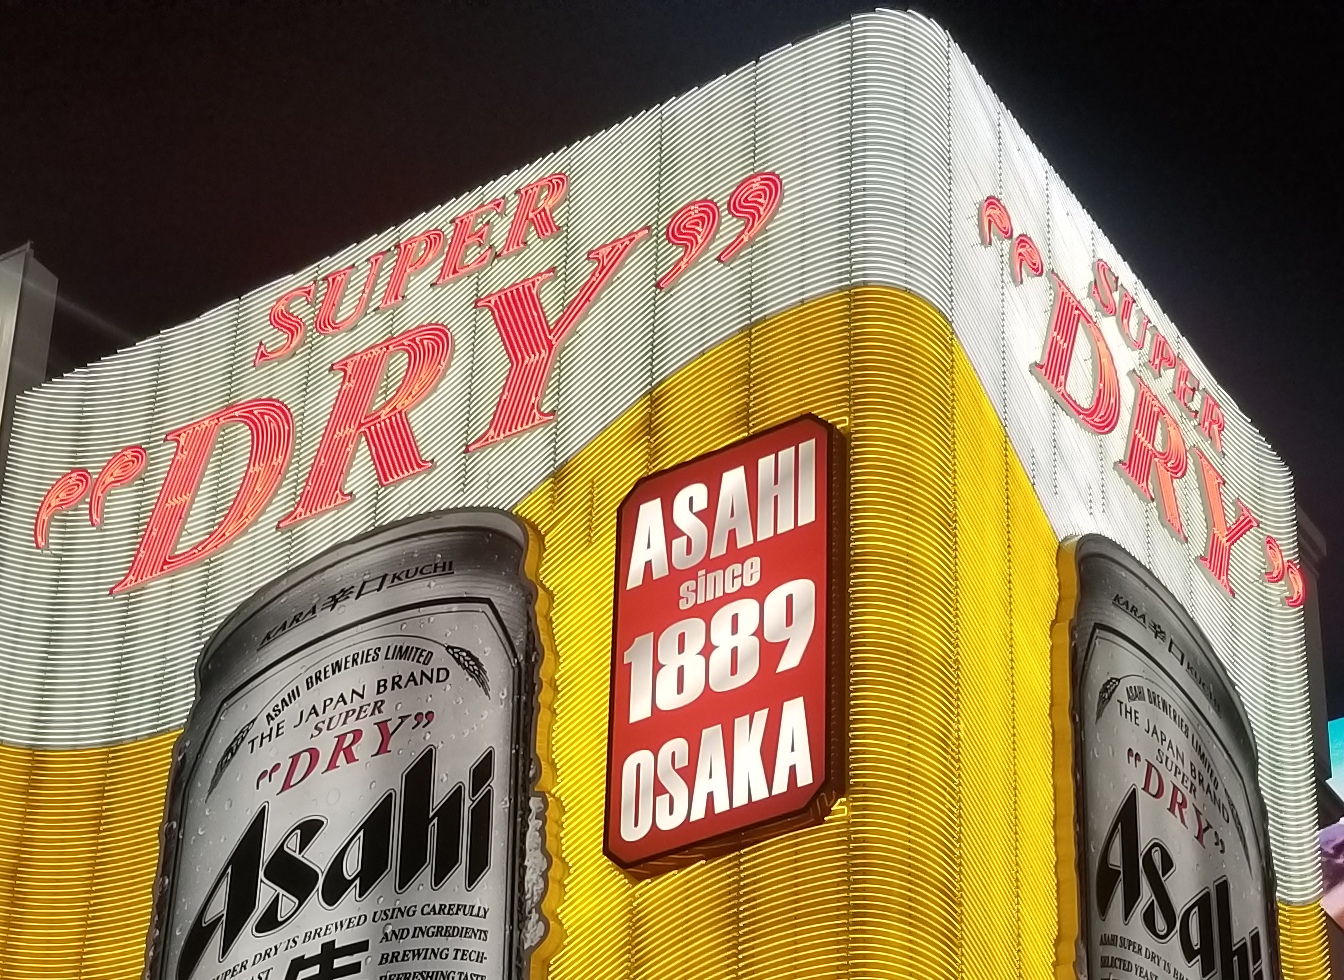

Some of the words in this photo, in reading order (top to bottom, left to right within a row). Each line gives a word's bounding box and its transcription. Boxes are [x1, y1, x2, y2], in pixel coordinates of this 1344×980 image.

[255, 171, 570, 367] SUPER
[1089, 260, 1225, 455] SUPER
[626, 438, 816, 590] ASAHI
[679, 556, 761, 610] since
[265, 685, 301, 726] ASAHI
[306, 646, 381, 691] BREWERIES
[384, 644, 434, 666] LIMITED
[623, 579, 816, 724] 1889
[248, 720, 286, 754] THE
[294, 684, 366, 729] JAPAN
[377, 667, 451, 695] BRAND
[310, 699, 385, 739] SUPER
[620, 696, 814, 842] OSAKA
[1117, 699, 1140, 727] THE
[1144, 718, 1185, 767] JAPAN
[1190, 761, 1230, 823] BRAND
[1156, 748, 1197, 799] SUPER
[251, 942, 281, 971] DRY
[301, 914, 368, 944] BREWED
[372, 904, 417, 924] USING
[420, 903, 490, 920] CAREFULLY
[378, 947, 450, 966] BREWING
[379, 927, 410, 944] AND
[411, 925, 489, 942] INGREDIENTS
[1119, 935, 1143, 956] SUPER
